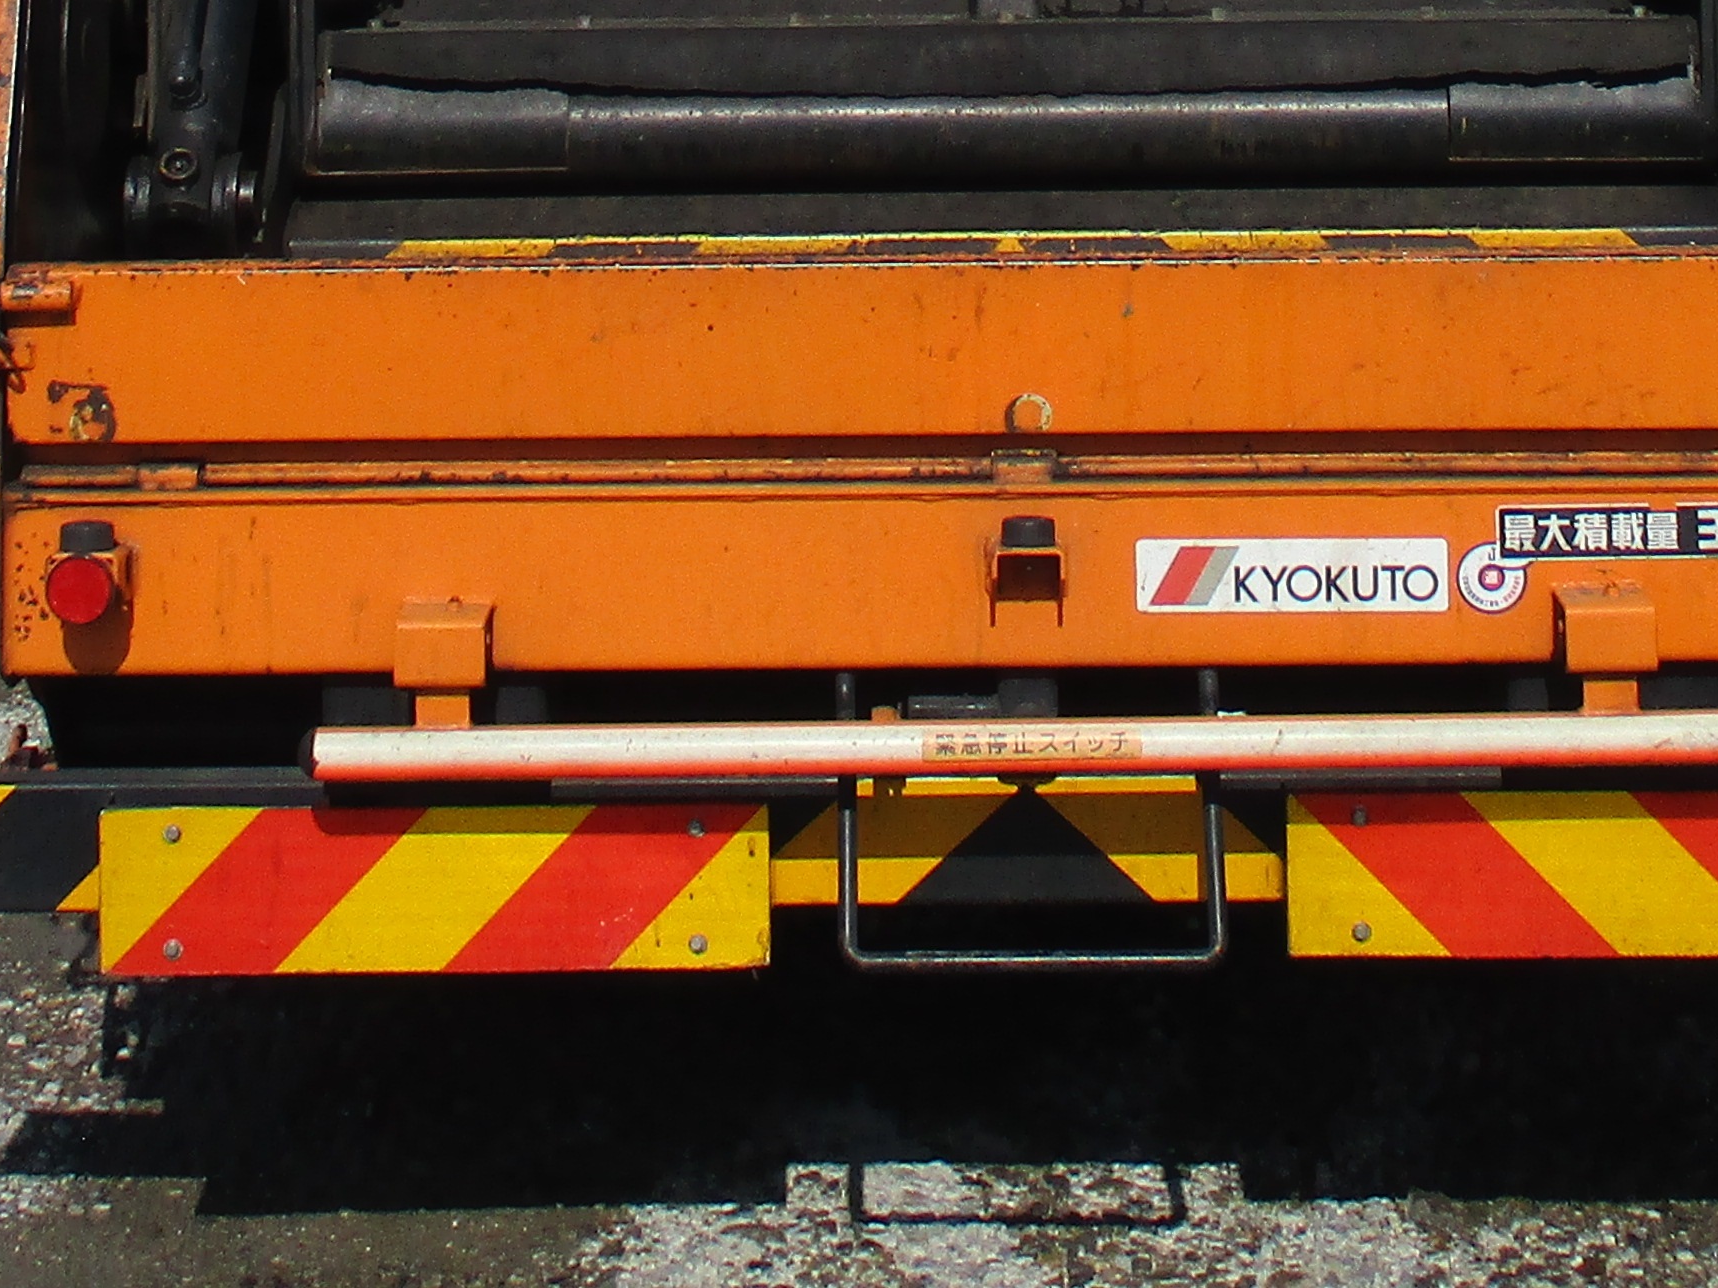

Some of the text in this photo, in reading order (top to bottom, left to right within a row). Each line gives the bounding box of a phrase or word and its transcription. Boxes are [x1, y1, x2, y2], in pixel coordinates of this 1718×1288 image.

[1503, 512, 1681, 552] 最大積載量
[1233, 564, 1439, 605] KYOKUTO
[935, 731, 1129, 757] 緊急停止スイッチ
